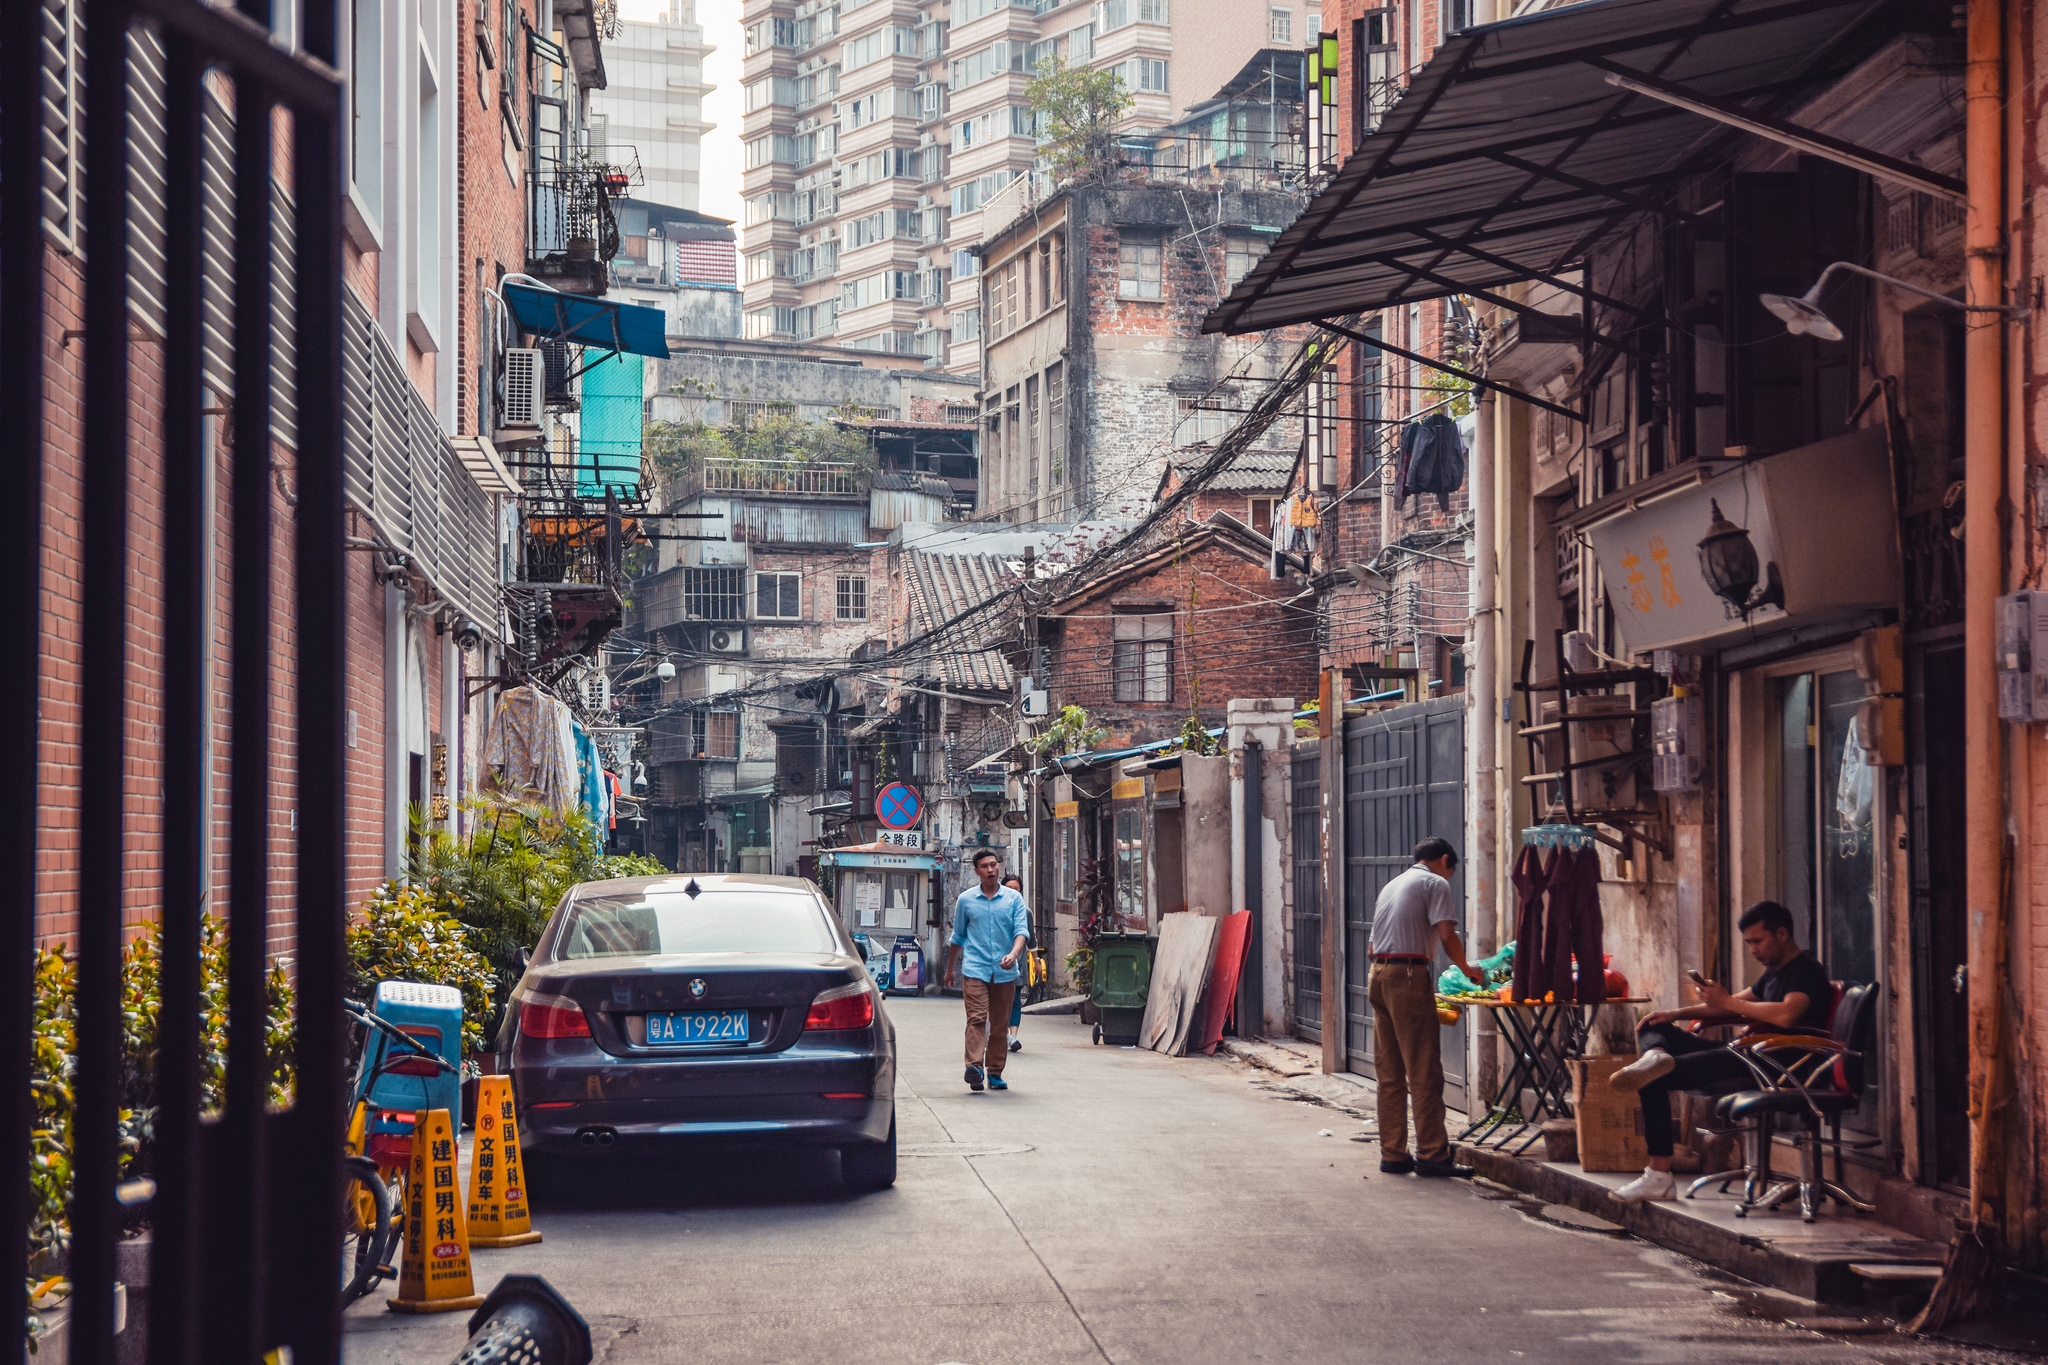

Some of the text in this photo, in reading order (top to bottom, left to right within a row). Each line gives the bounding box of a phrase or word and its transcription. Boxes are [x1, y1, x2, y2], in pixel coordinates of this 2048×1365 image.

[880, 832, 918, 847] 全路段
[478, 1137, 494, 1200] 文明停车
[501, 1100, 519, 1187] 建国男科
[409, 1182, 423, 1256] 文明停车
[432, 1138, 456, 1241] 建国男科
[470, 1213, 499, 1221] 好司机
